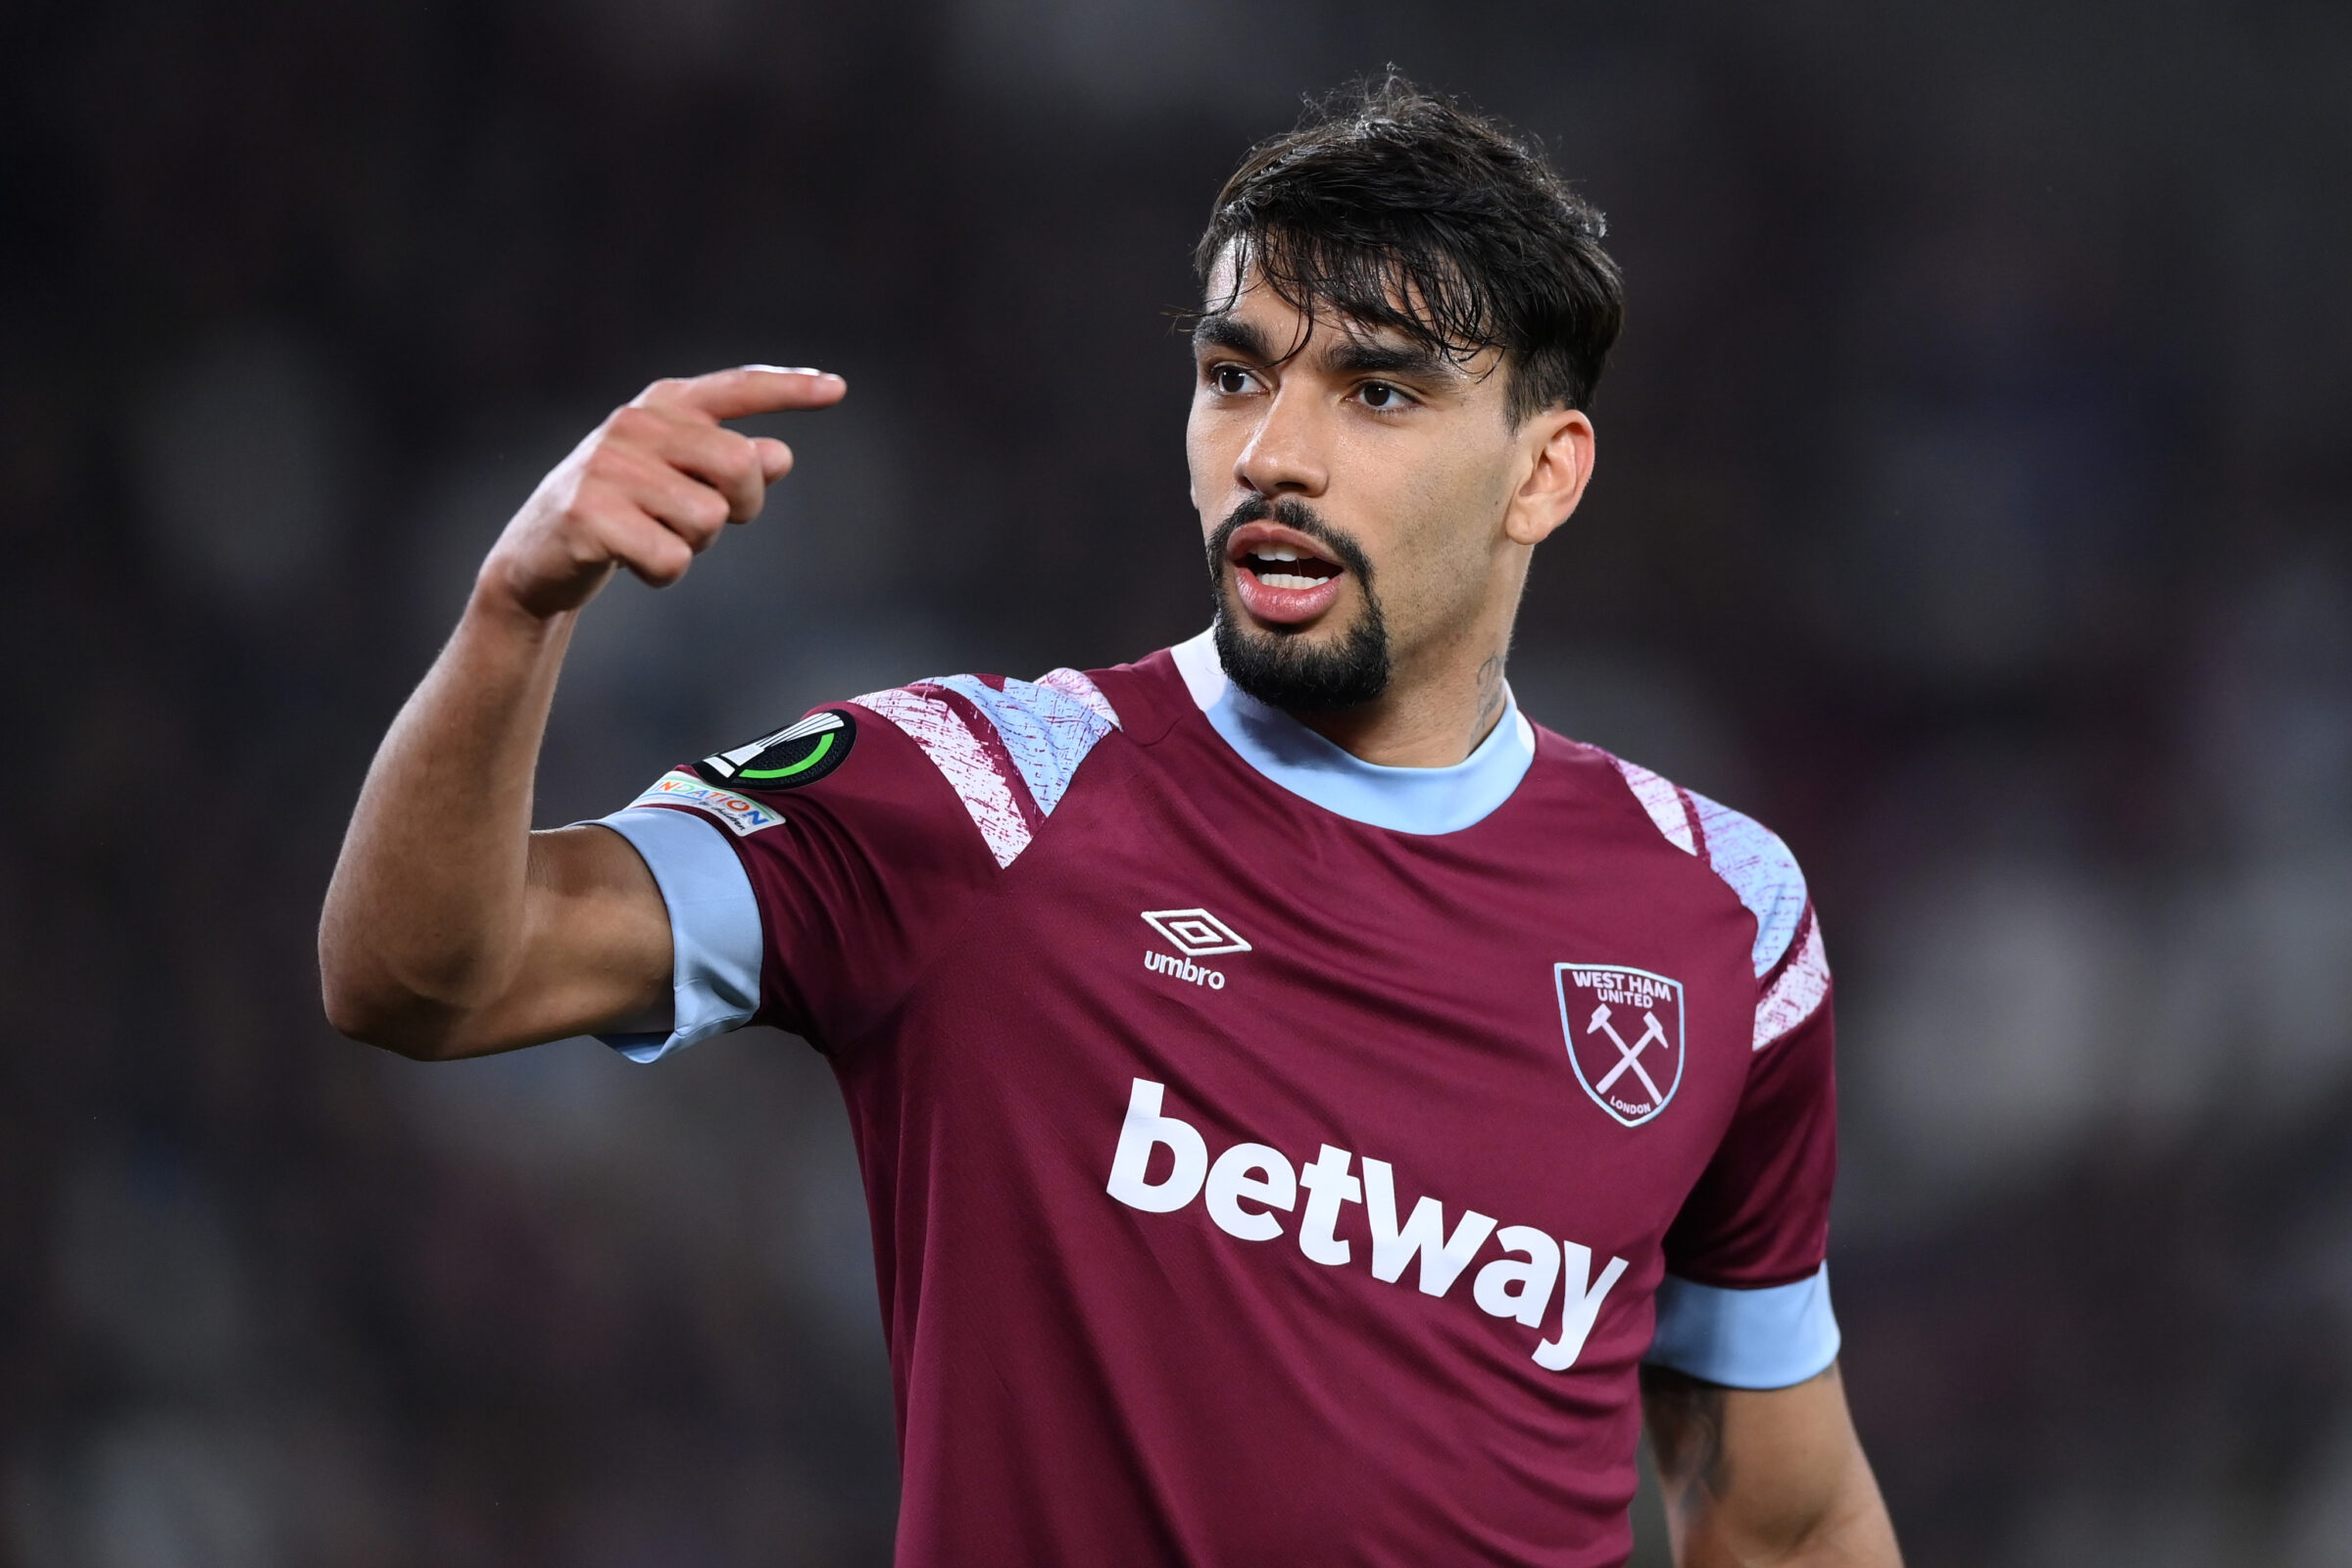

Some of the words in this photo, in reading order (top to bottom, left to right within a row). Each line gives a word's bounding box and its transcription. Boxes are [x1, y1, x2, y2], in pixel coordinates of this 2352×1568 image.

[1144, 950, 1226, 990] umbro
[1572, 970, 1625, 990] WEST
[1629, 975, 1672, 1002] HAM
[1596, 989, 1654, 1009] UNITED
[1609, 1095, 1652, 1115] LONDON
[1105, 1076, 1630, 1371] betway
